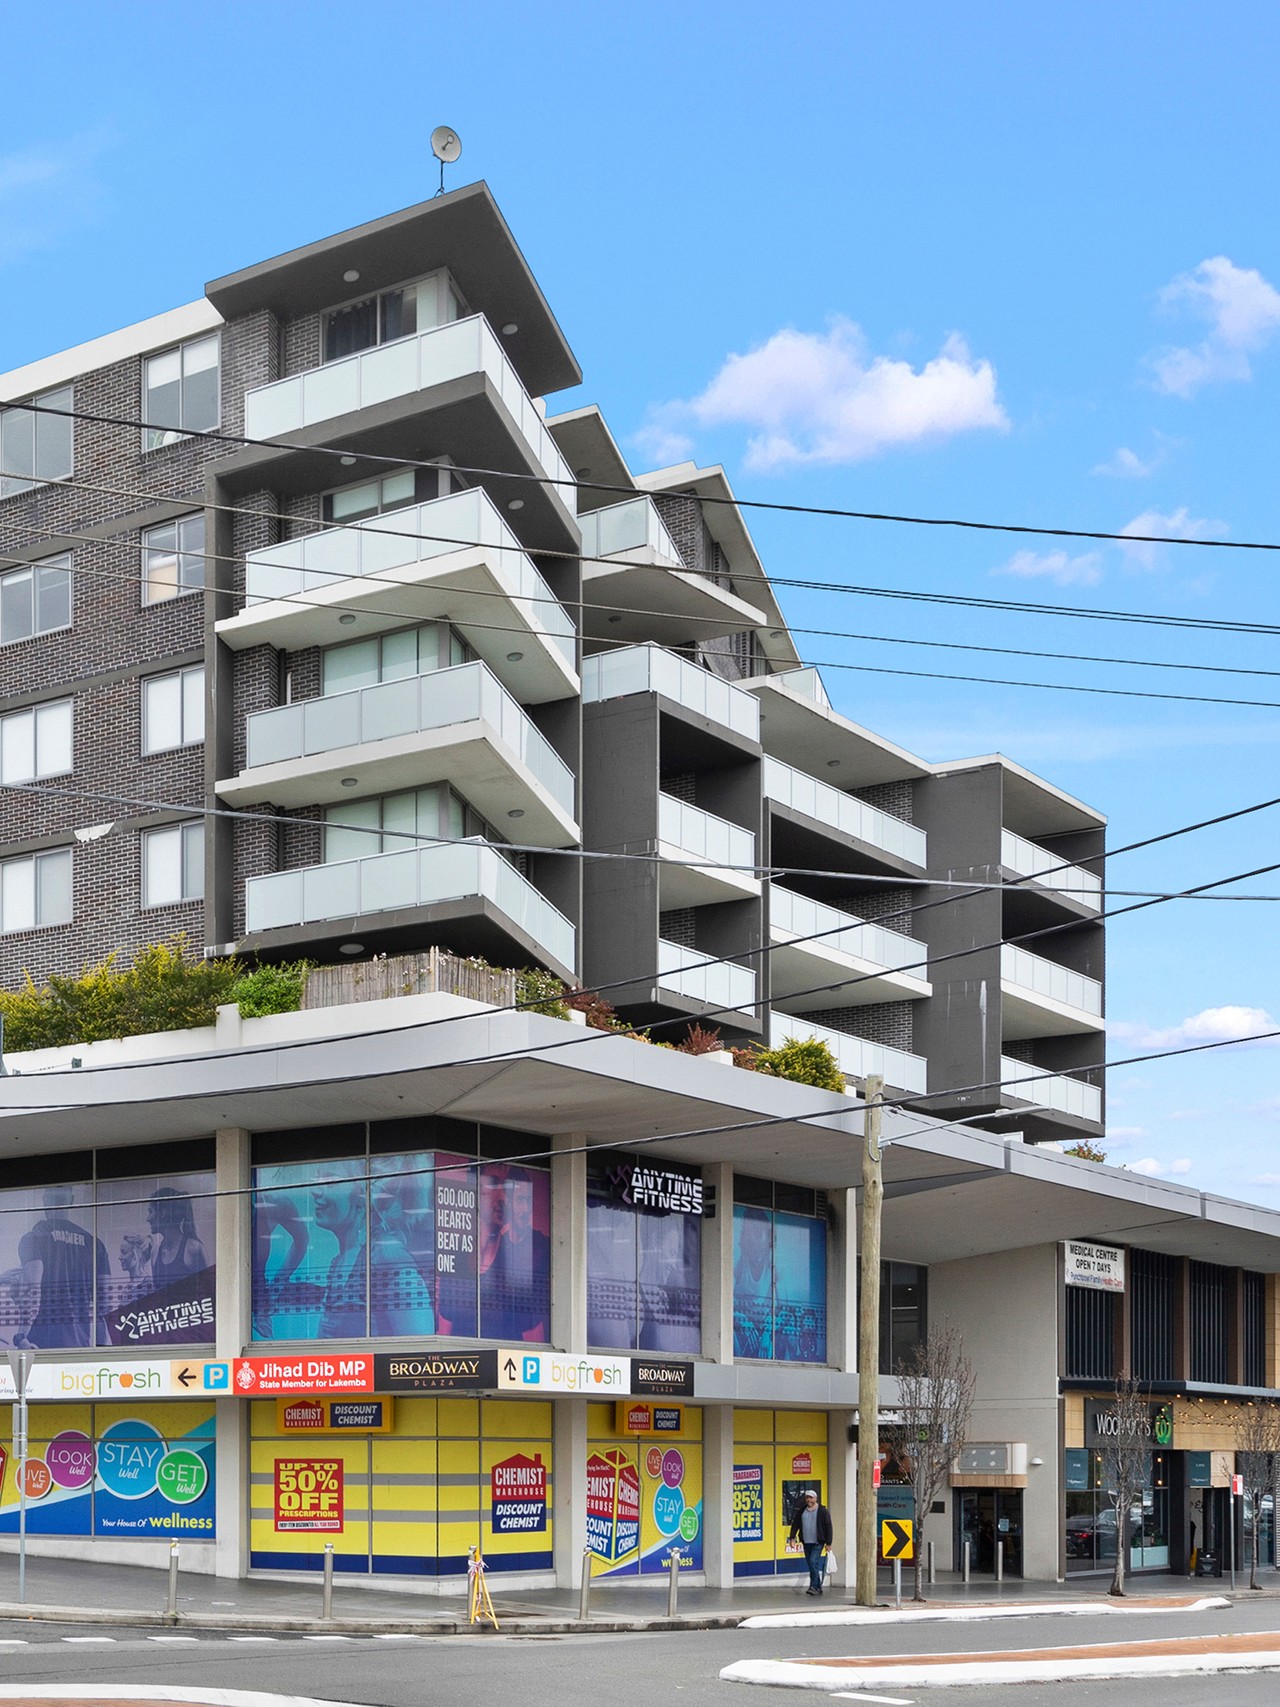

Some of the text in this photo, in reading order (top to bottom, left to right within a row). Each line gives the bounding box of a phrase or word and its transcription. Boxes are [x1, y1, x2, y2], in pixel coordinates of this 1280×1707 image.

[631, 1167, 703, 1198] ANYTIME
[437, 1186, 475, 1209] 500,000
[633, 1188, 703, 1214] FITNESS
[437, 1209, 472, 1231] HEARTS
[437, 1231, 473, 1253] BEAT AS
[1069, 1244, 1118, 1262] MEDICAL CENTRE
[437, 1254, 456, 1273] ONE
[1075, 1258, 1111, 1273] OPEN 7 DAYS
[137, 1298, 213, 1326] ANYTIME
[139, 1311, 214, 1337] FITNESS
[259, 1360, 366, 1378] Jihad Dib MP
[389, 1361, 480, 1376] BROADWAY
[638, 1367, 686, 1383] BROADWAY
[260, 1378, 367, 1389] State Member for Lakemba
[414, 1379, 455, 1387] PLAZA
[285, 1408, 322, 1420] CHEMIST
[335, 1405, 378, 1414] DISCOUNT
[338, 1415, 374, 1425] CHEMIST
[51, 1450, 92, 1466] LOOK
[103, 1442, 159, 1468] STAY
[69, 1466, 87, 1476] Well
[119, 1468, 139, 1479] Well
[161, 1462, 202, 1482] GET
[495, 1468, 543, 1486] CHEMIST
[664, 1462, 682, 1474] LOOK
[176, 1483, 196, 1494] Well
[279, 1470, 338, 1492] 50%
[587, 1477, 615, 1498] EMIST
[495, 1487, 544, 1496] WAREHOUSE
[618, 1478, 639, 1507] CHEMIS
[733, 1490, 762, 1511] 85%
[279, 1492, 338, 1510] OFF
[496, 1503, 543, 1515] DISCOUNT
[657, 1496, 681, 1515] STAY
[102, 1512, 213, 1529] Your House Of wellness
[500, 1517, 540, 1529] CHEMIST
[681, 1515, 697, 1528] GET
[733, 1511, 755, 1529] OFF
[587, 1533, 609, 1553] EMIST
[661, 1557, 693, 1568] weness
